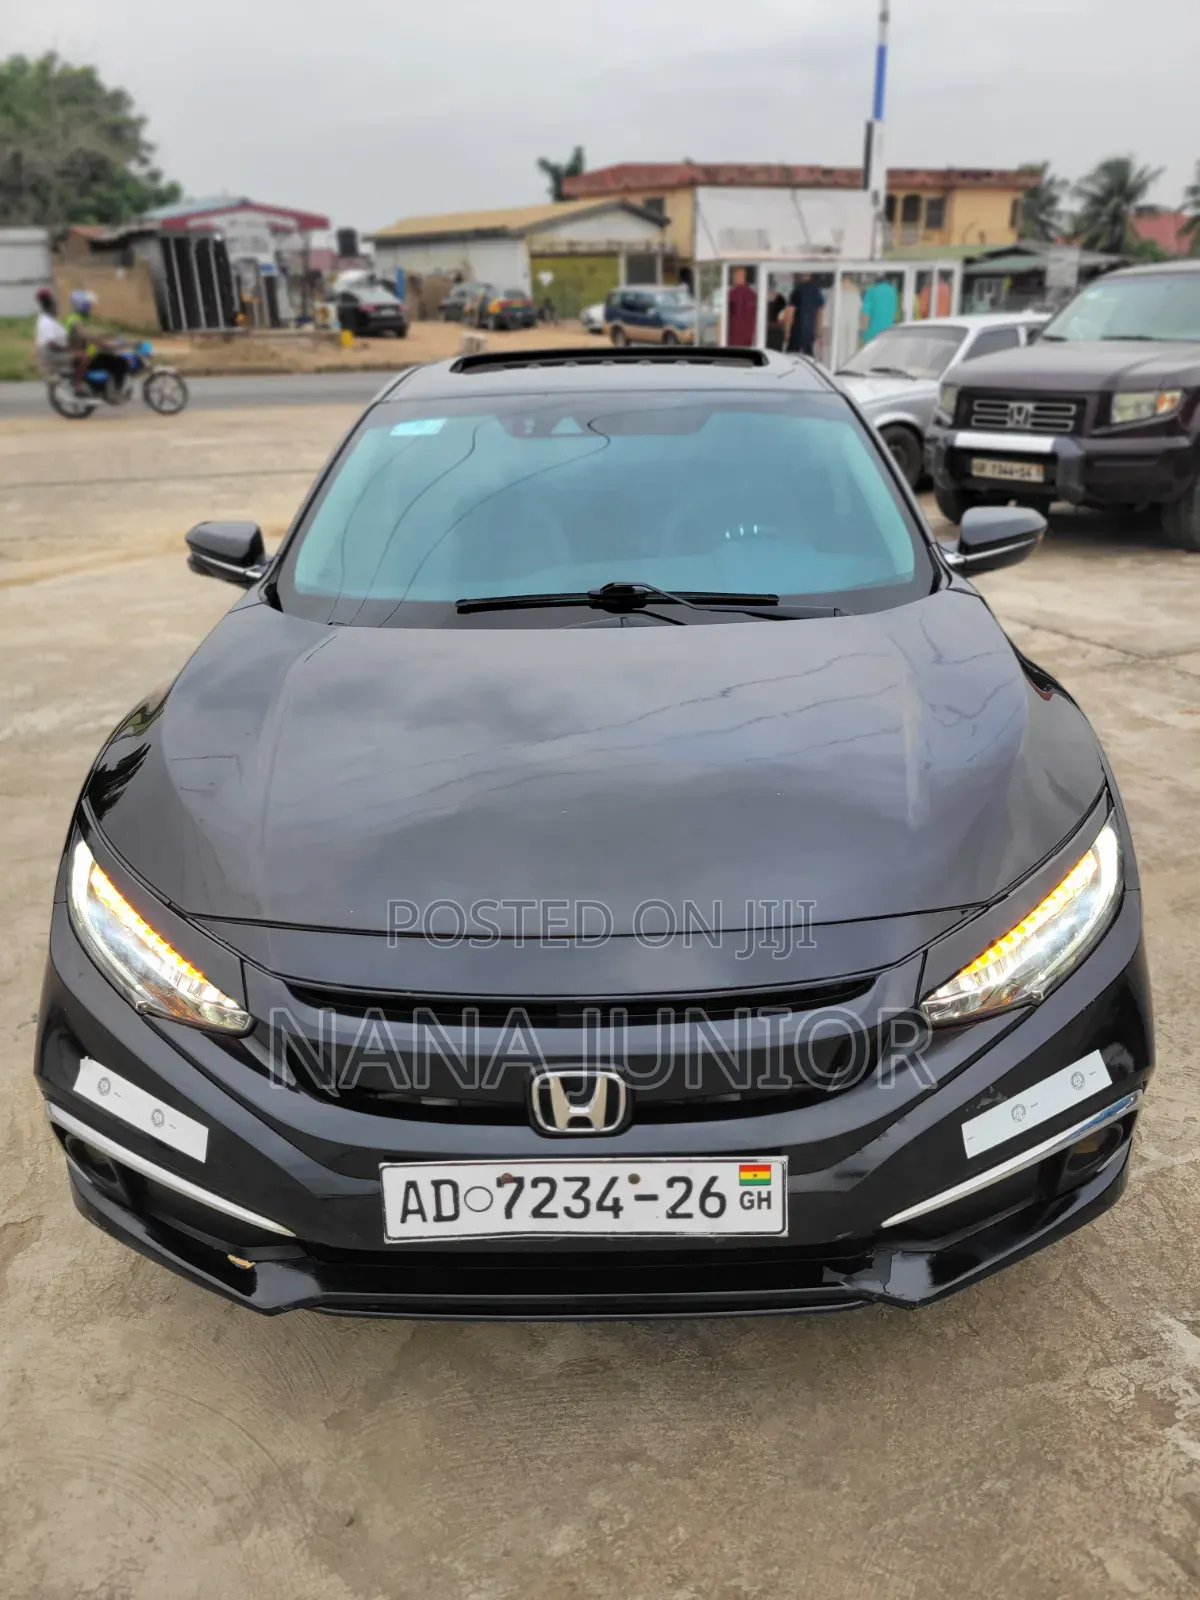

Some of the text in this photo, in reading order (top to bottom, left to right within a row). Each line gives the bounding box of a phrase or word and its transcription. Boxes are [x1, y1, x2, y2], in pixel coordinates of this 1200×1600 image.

[400, 1175, 772, 1224] AD 7234-26 GH
